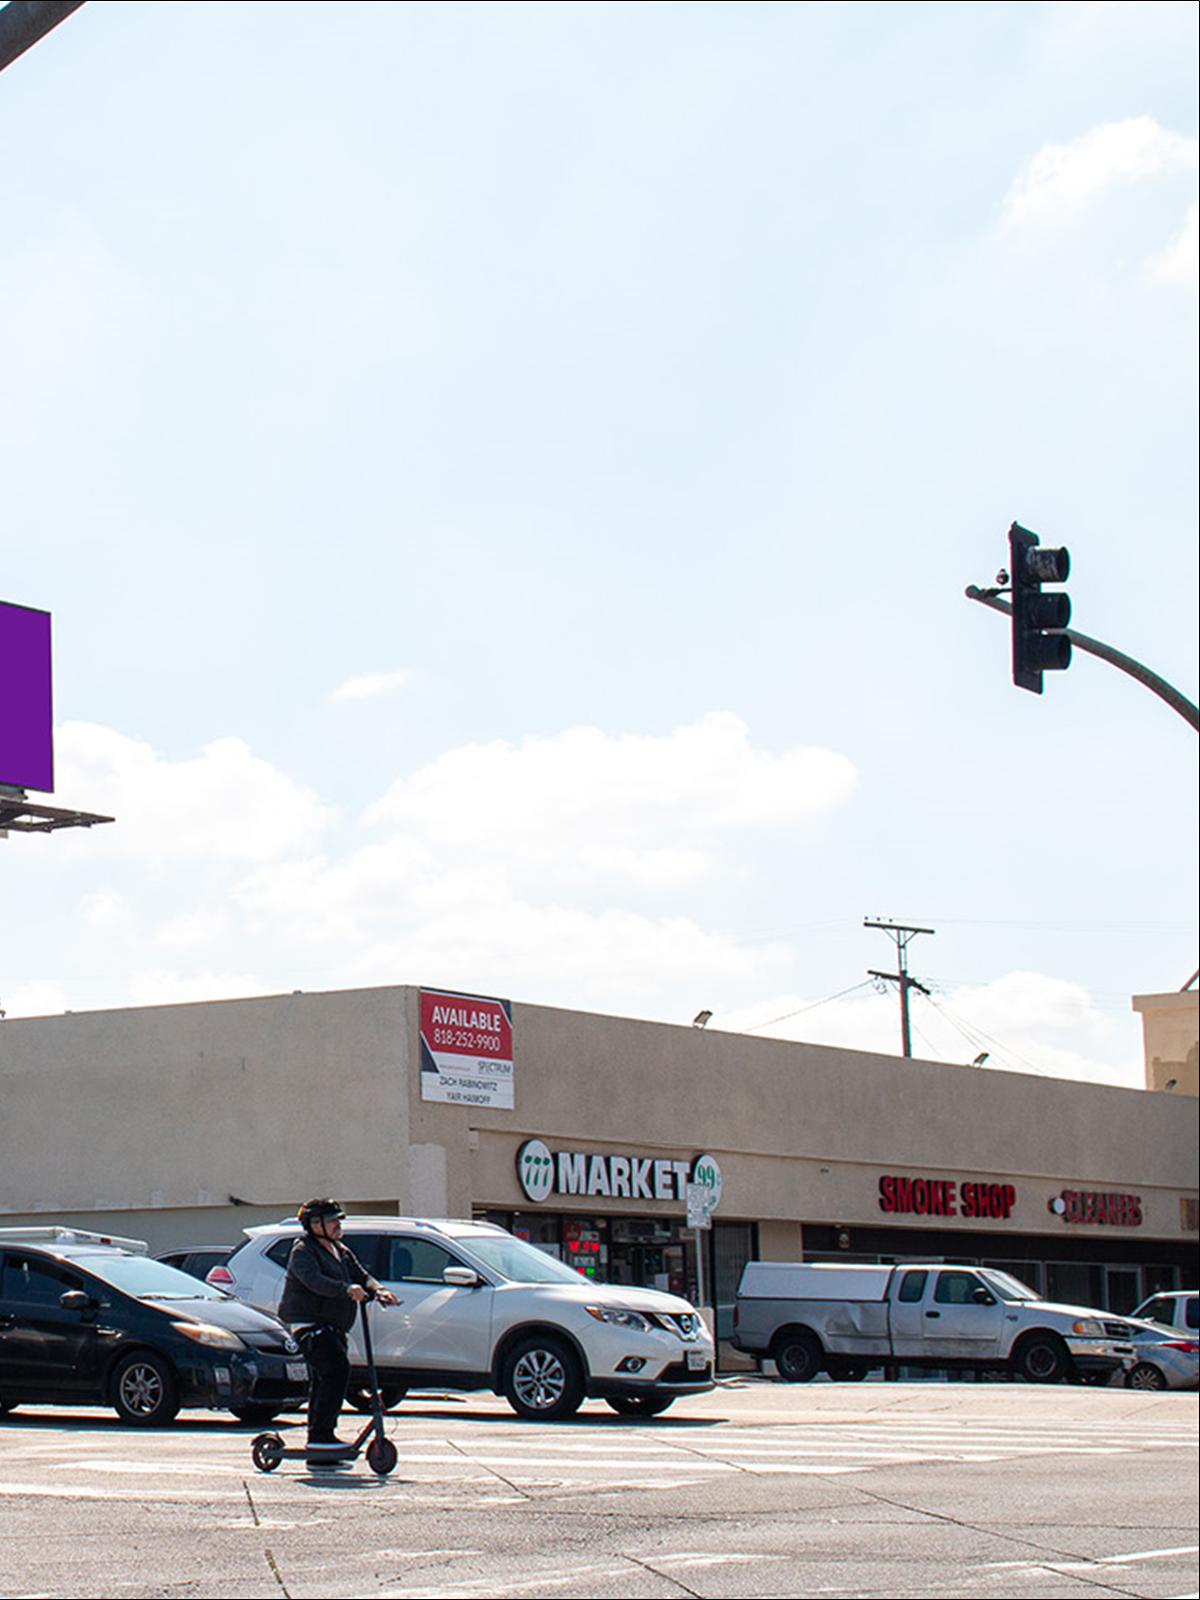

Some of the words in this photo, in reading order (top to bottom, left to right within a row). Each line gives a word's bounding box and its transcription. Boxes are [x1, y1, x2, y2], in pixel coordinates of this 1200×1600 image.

[431, 1005, 501, 1032] AVAILABLE
[433, 1028, 500, 1052] 818-252-9900
[557, 1152, 690, 1200] MARKET
[878, 1175, 957, 1216] SMOKE
[960, 1182, 1017, 1219] SHOP
[1061, 1190, 1143, 1227] CLEANERS
